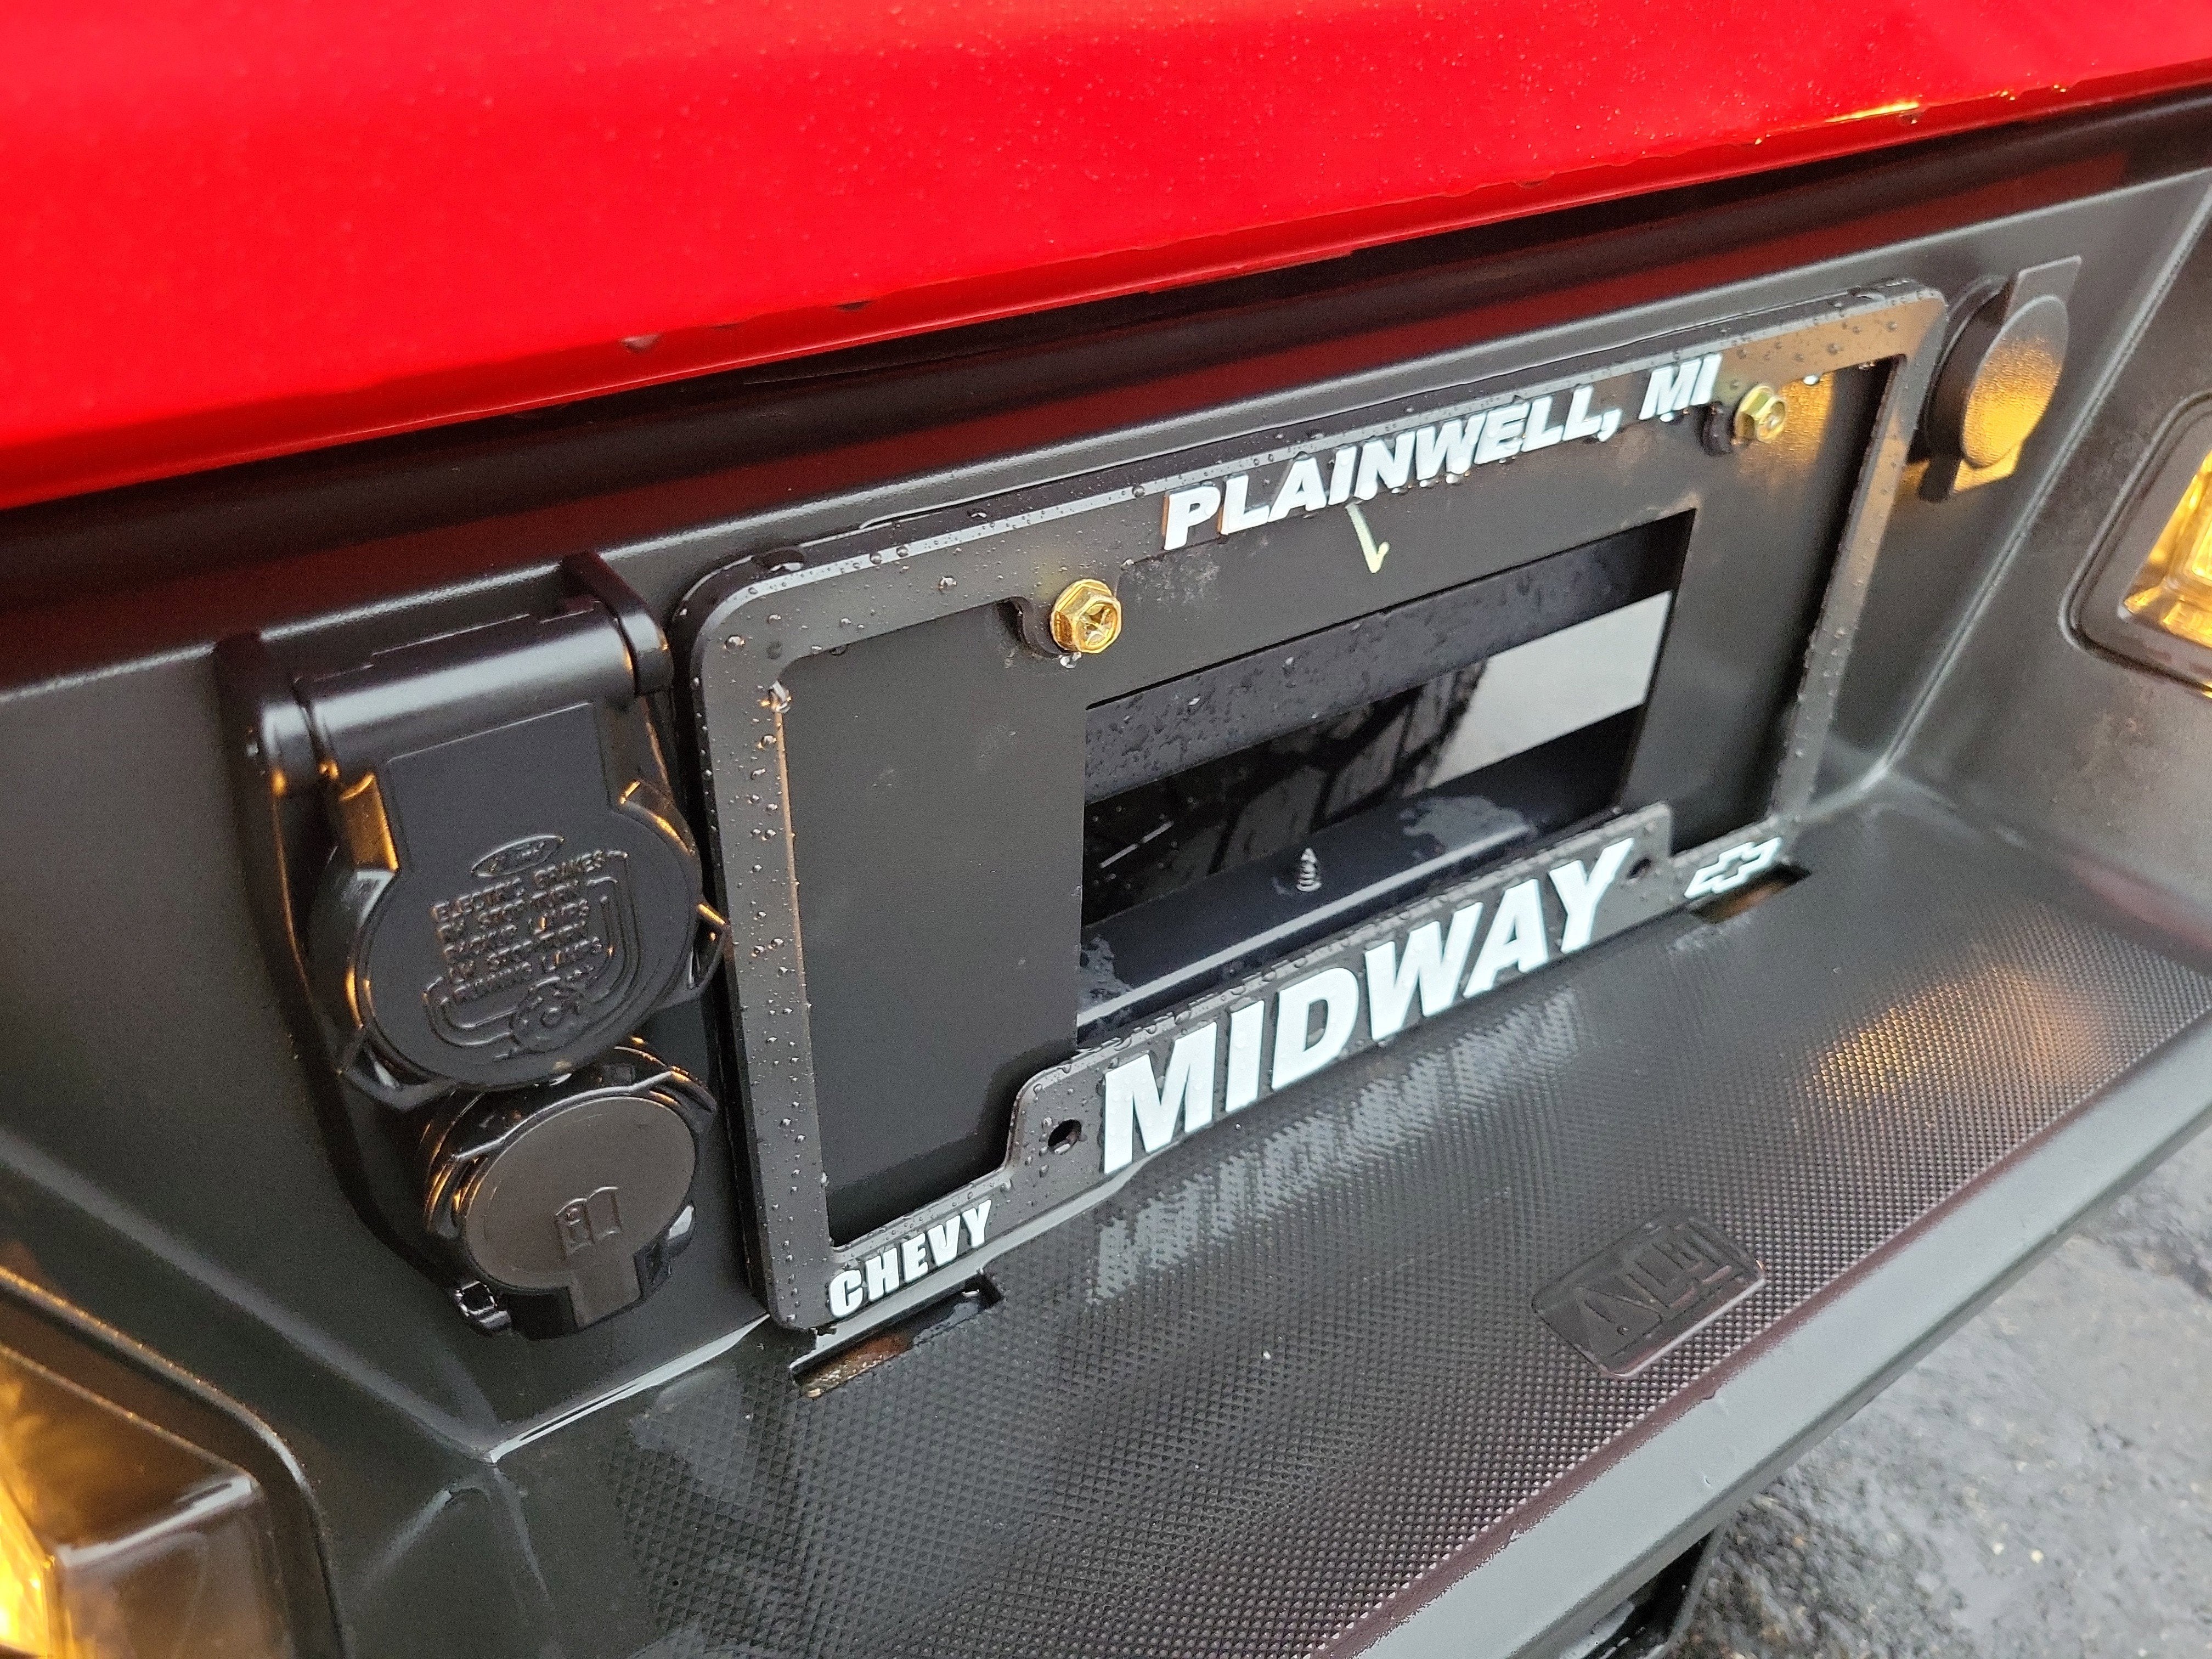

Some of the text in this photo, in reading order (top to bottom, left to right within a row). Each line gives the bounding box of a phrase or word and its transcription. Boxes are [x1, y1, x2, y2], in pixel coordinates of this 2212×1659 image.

[1163, 353, 1723, 551] PLAINWELL, MI
[1104, 837, 1634, 1175] MIDWAY
[828, 1199, 992, 1318] CHEVY
